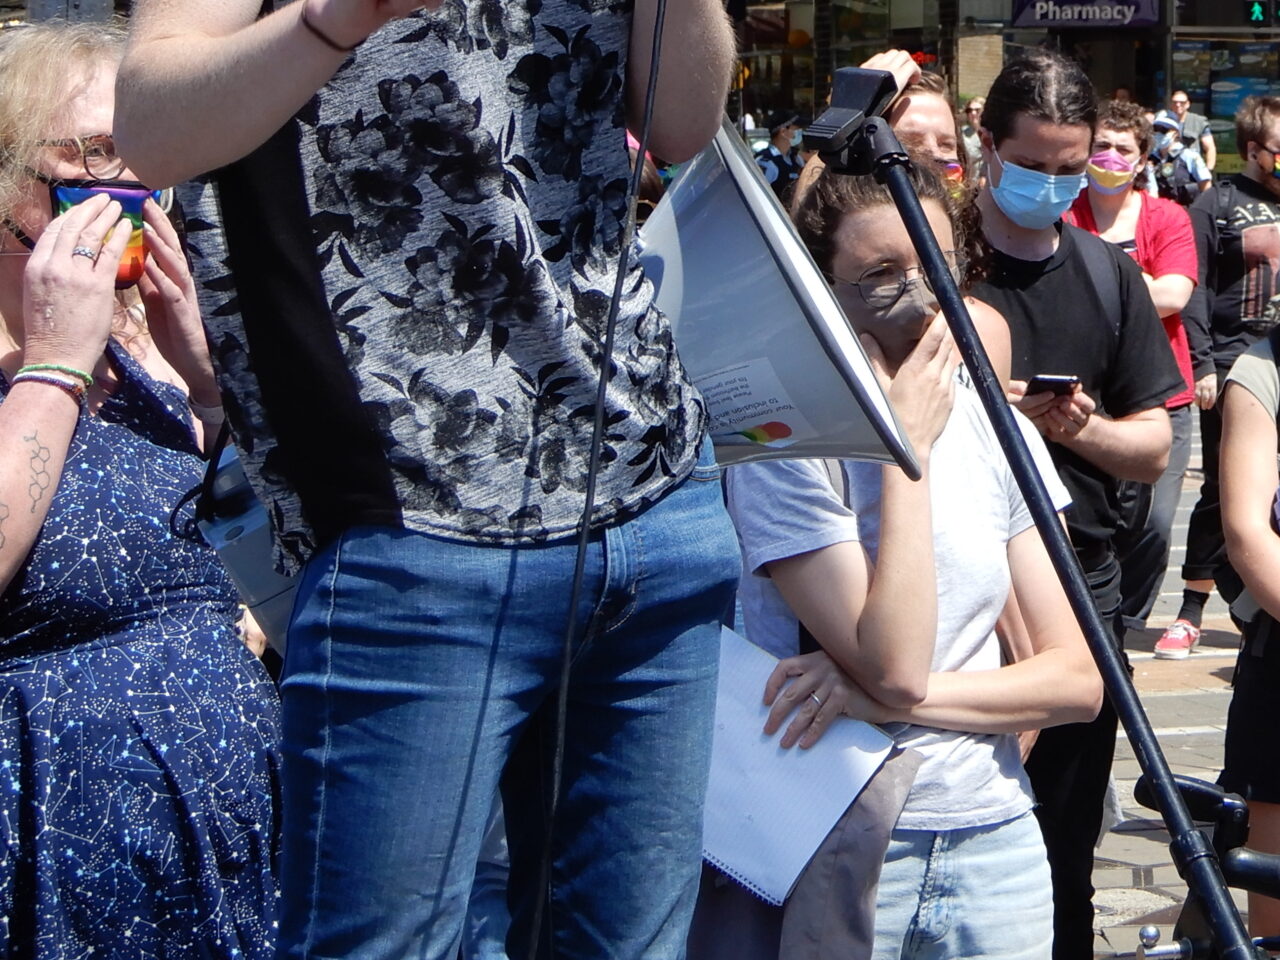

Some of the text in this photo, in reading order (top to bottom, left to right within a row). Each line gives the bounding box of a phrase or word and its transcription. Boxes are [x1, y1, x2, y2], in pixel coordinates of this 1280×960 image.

[731, 400, 767, 415] inclusion
[775, 403, 794, 413] Your
[714, 410, 730, 421] and
[728, 408, 774, 425] community
